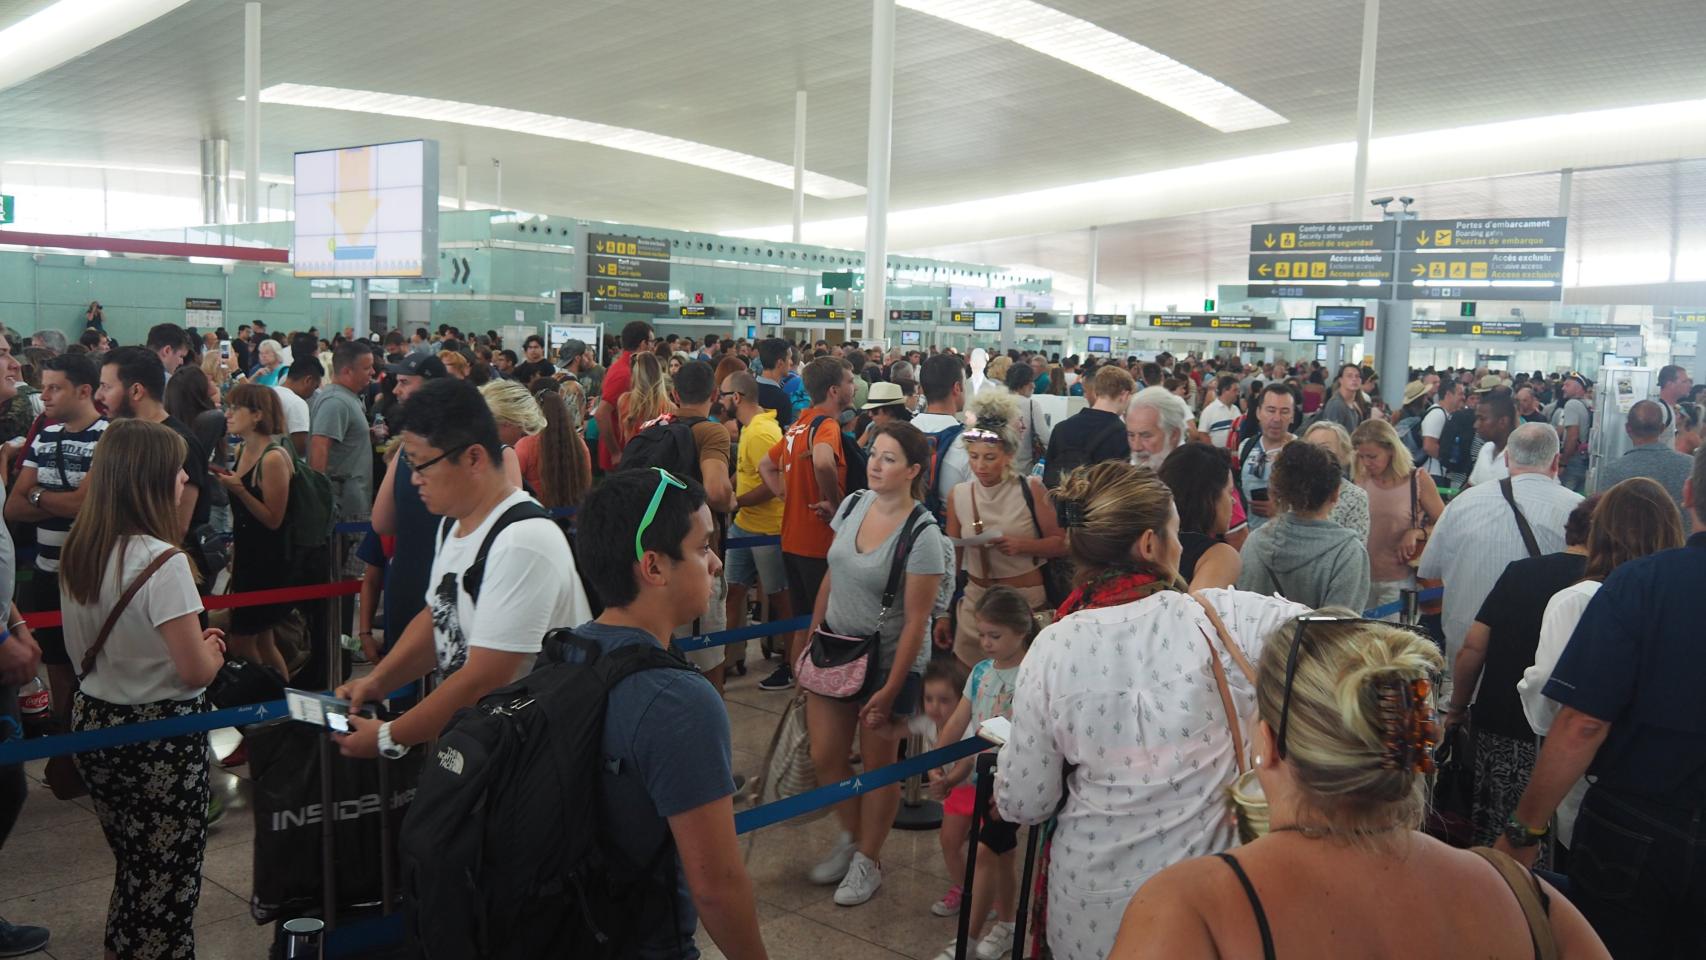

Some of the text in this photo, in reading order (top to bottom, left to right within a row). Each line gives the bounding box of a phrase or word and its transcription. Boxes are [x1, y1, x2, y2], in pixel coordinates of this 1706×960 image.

[1298, 224, 1373, 233] Control de seguretat
[1456, 220, 1550, 230] Portes d'embarcament
[1298, 232, 1344, 240] Security control
[1326, 239, 1336, 247] de
[1488, 236, 1499, 245] de
[1501, 236, 1544, 246] embarque
[1352, 254, 1383, 263] exclusiu
[1492, 253, 1552, 262] Accés exclusiu
[1520, 262, 1543, 270] access
